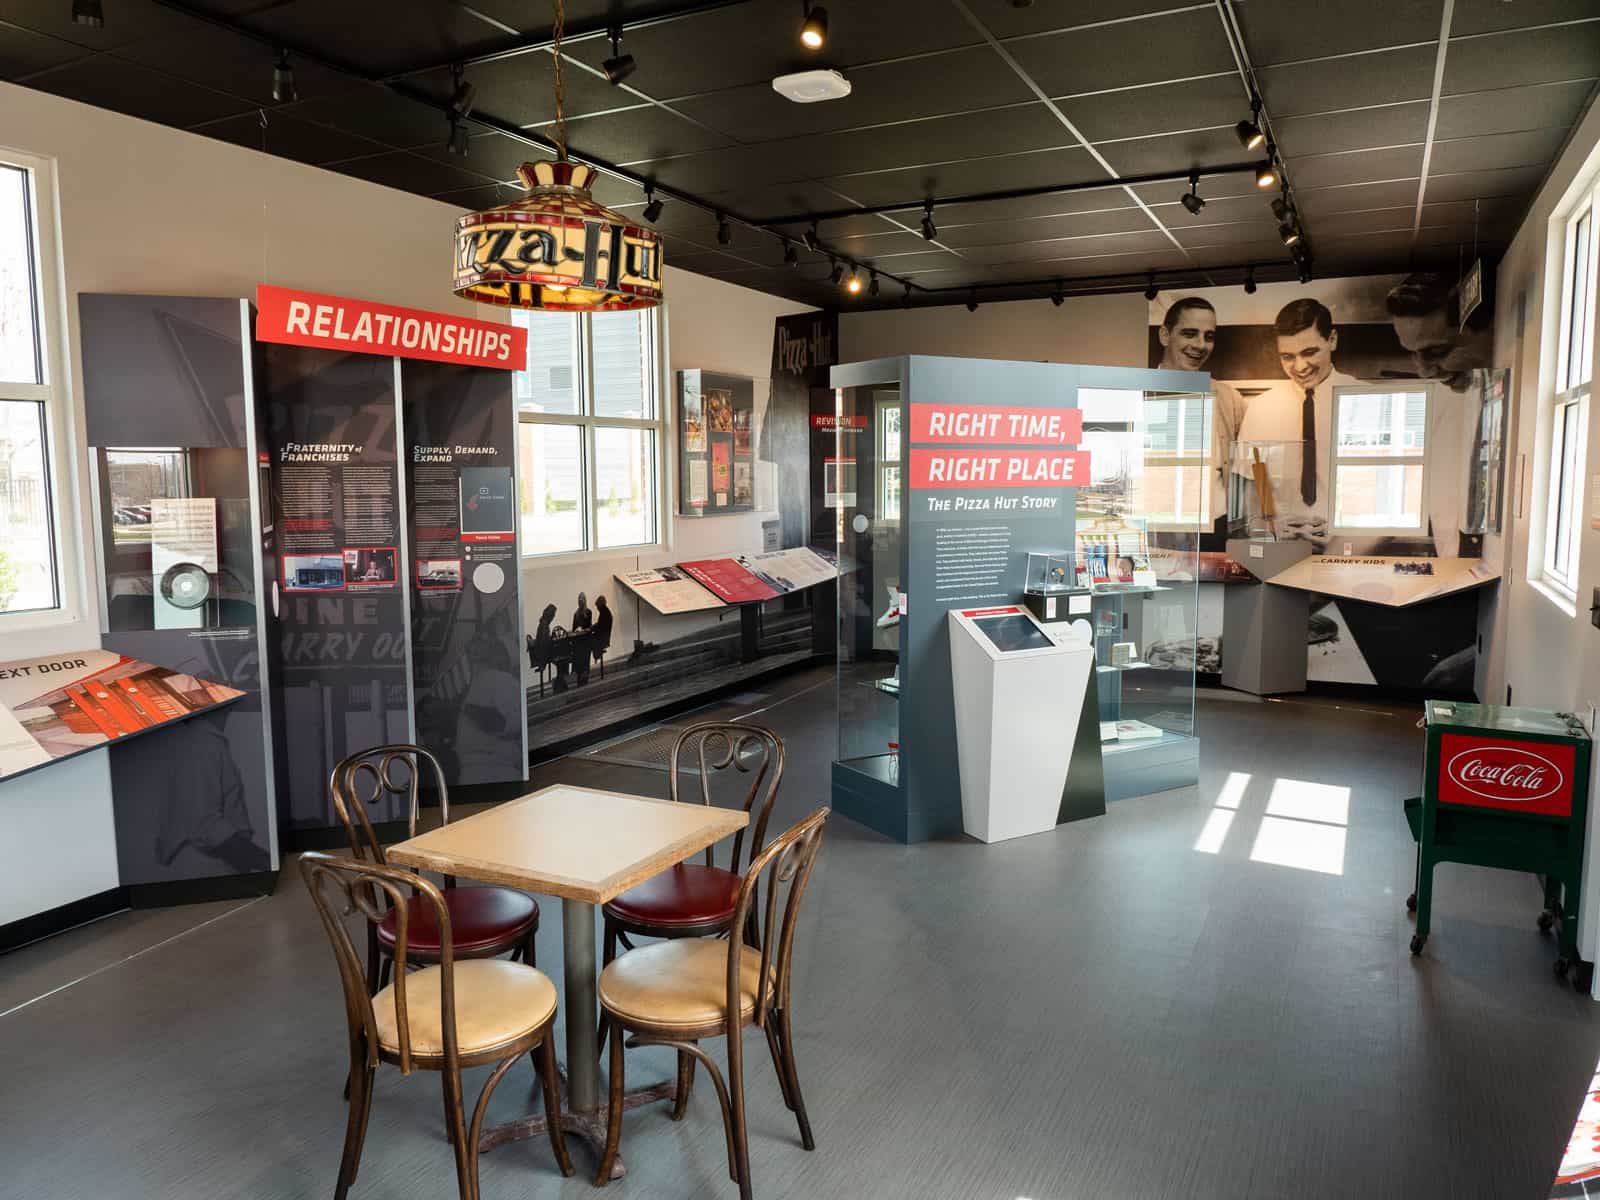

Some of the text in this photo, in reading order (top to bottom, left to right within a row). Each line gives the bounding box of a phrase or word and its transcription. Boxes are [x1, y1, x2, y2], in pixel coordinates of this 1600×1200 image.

[286, 300, 512, 361] RELATIONSHIPS
[929, 411, 1066, 442] RIGHT TIME,
[281, 452, 350, 462] FRANCHISES
[286, 442, 355, 453] FRATERNITY
[413, 445, 499, 456] SUPPLY, DEMAND,
[414, 453, 453, 463] EXPAND
[928, 457, 1076, 482] RIGHT PLACE
[928, 495, 1058, 512] THE PIZZA HUT STORY
[0, 658, 88, 680] EXT DOOR
[1460, 759, 1549, 790] Coca-Cola
